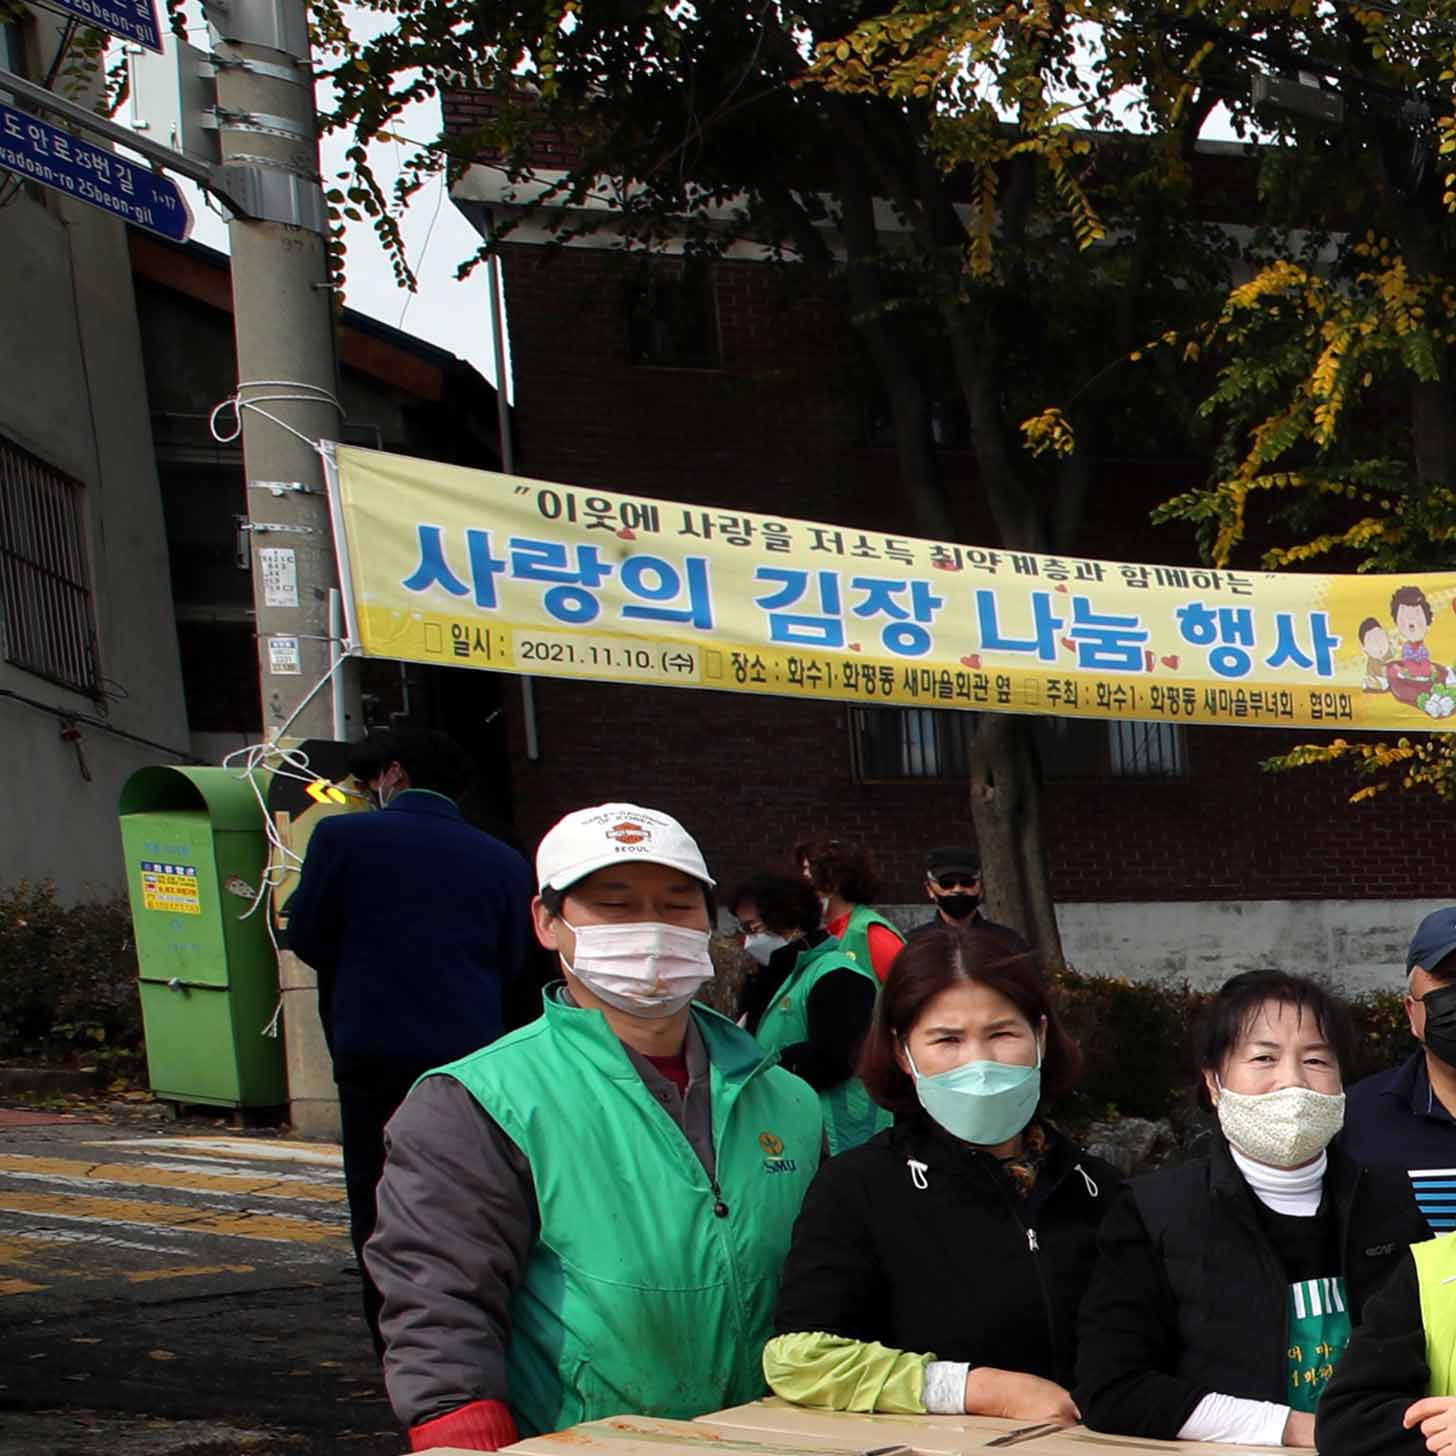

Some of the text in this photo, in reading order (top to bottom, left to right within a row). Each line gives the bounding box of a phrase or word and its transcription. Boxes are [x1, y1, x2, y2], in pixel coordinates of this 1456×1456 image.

[79, 178, 154, 225] 25beon-gil
[677, 508, 793, 554] 사랑을
[807, 526, 917, 567] 저소득
[402, 521, 714, 630] 사랑의
[752, 564, 945, 658] 김장
[974, 587, 1150, 672] 나눔
[1174, 600, 1342, 678] 행사
[451, 622, 494, 661] 일시
[730, 651, 768, 684] 장소
[903, 667, 990, 702] 새마을회관
[1203, 688, 1294, 720] 새마을부녀회
